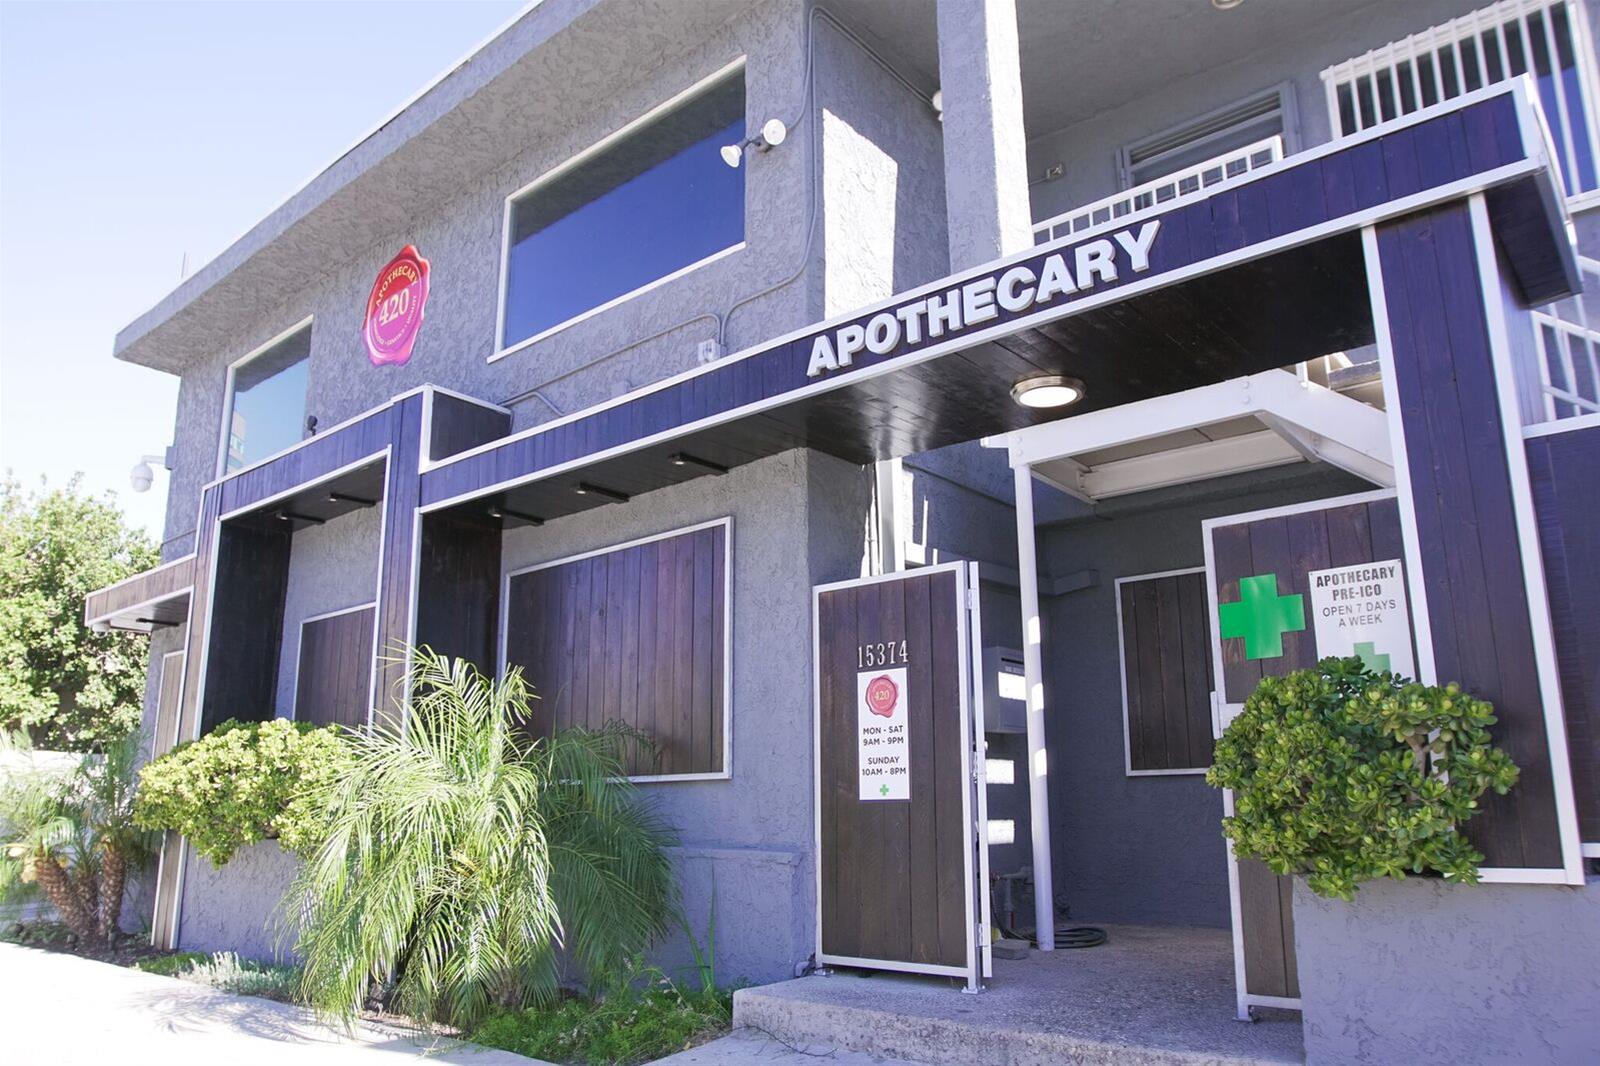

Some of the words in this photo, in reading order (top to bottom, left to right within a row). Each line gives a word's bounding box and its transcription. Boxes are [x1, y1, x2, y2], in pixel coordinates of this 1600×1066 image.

[376, 265, 418, 307] APOTHECARY
[379, 287, 410, 326] 420
[806, 220, 1161, 377] APOTHECARY
[1316, 566, 1395, 588] APOTHECARY
[1332, 583, 1382, 601] PRE-ICO
[1322, 605, 1353, 617] OPEN
[1356, 603, 1362, 613] 7
[1366, 599, 1397, 612] DAYS
[1338, 618, 1346, 628] A
[1348, 614, 1383, 627] WEEK
[858, 640, 908, 668] 15374
[863, 727, 881, 735] MON
[888, 725, 904, 733] SAT
[863, 738, 880, 746] 9AM
[868, 757, 900, 765] SUNDAY
[862, 768, 883, 776] 10AM
[889, 767, 906, 775] 8PM
